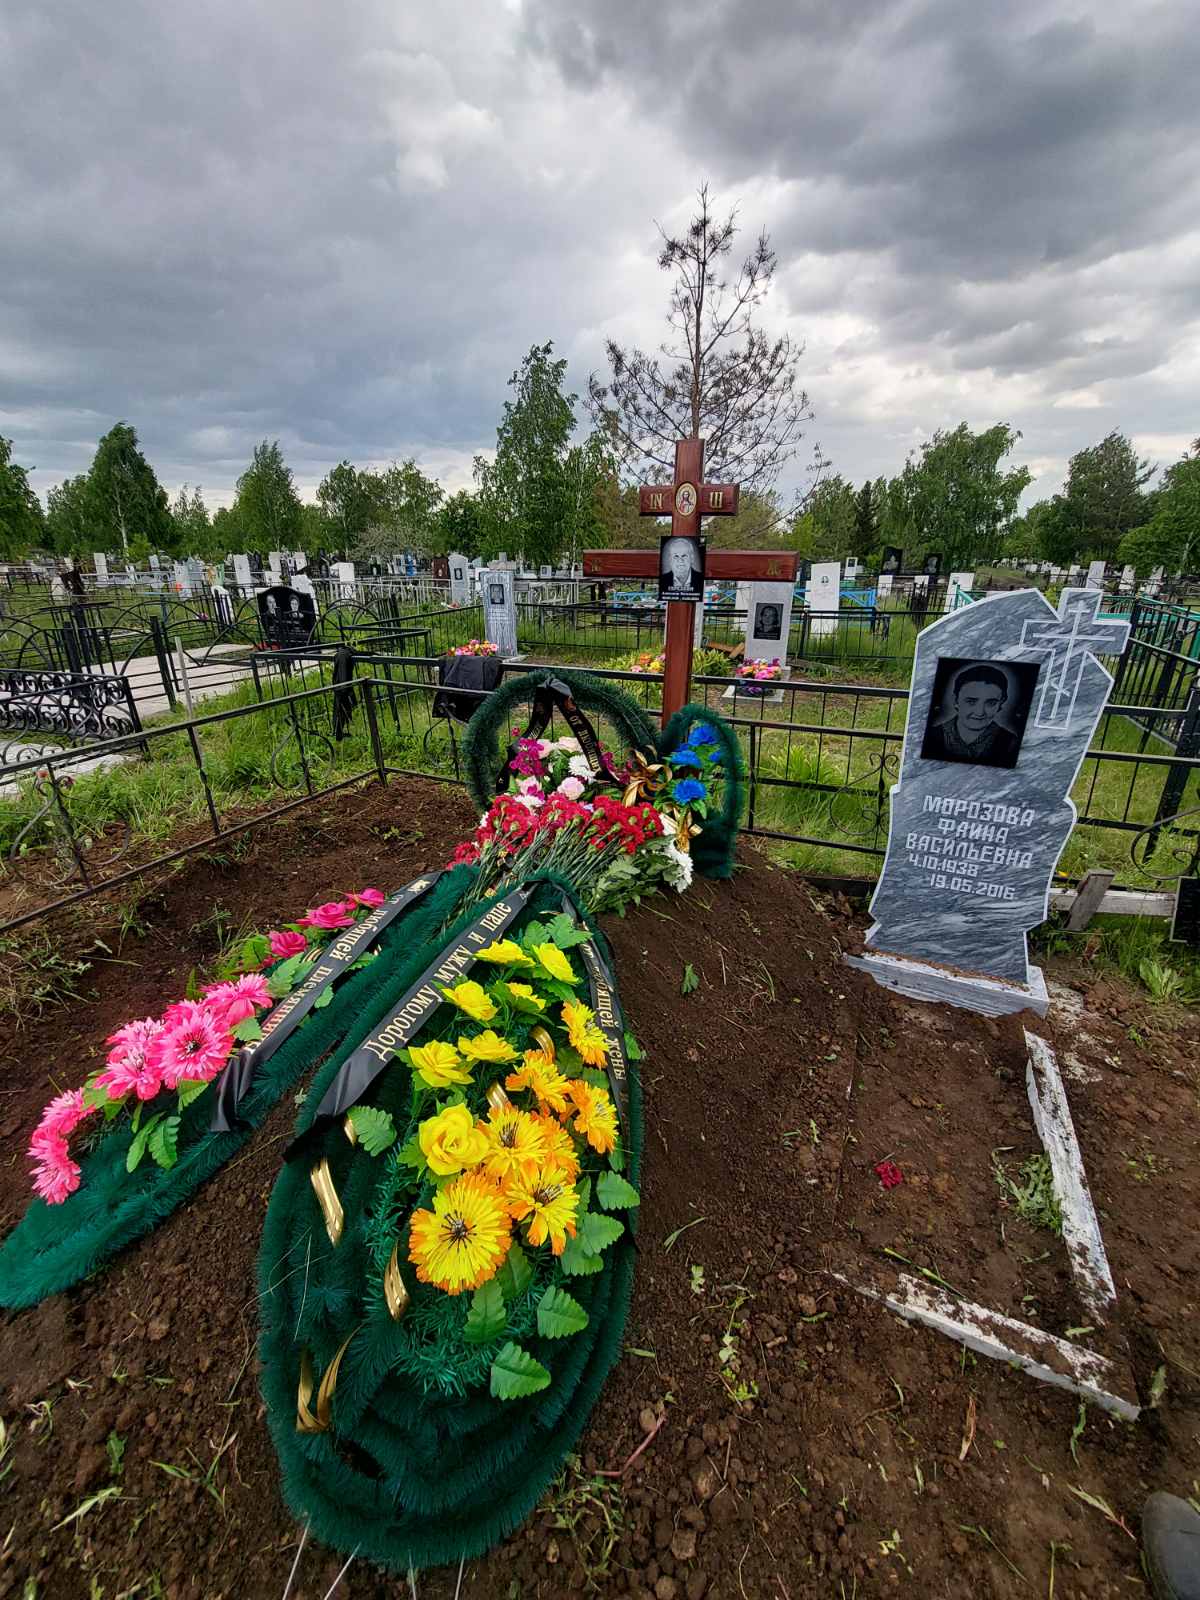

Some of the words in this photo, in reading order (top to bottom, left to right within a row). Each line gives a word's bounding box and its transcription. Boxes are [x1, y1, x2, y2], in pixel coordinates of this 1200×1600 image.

[922, 795, 1036, 828] МОРОЗОВА
[905, 832, 1034, 869] ВАСИЛЬЕВНА
[909, 853, 981, 878] 4.10.1938
[329, 909, 389, 962] любящей
[361, 984, 444, 1062] Дорогому
[433, 944, 477, 984] мужу
[467, 931, 487, 945] и
[480, 902, 513, 932] папе
[244, 965, 334, 1055] племянниы
[605, 1037, 627, 1082] жены
